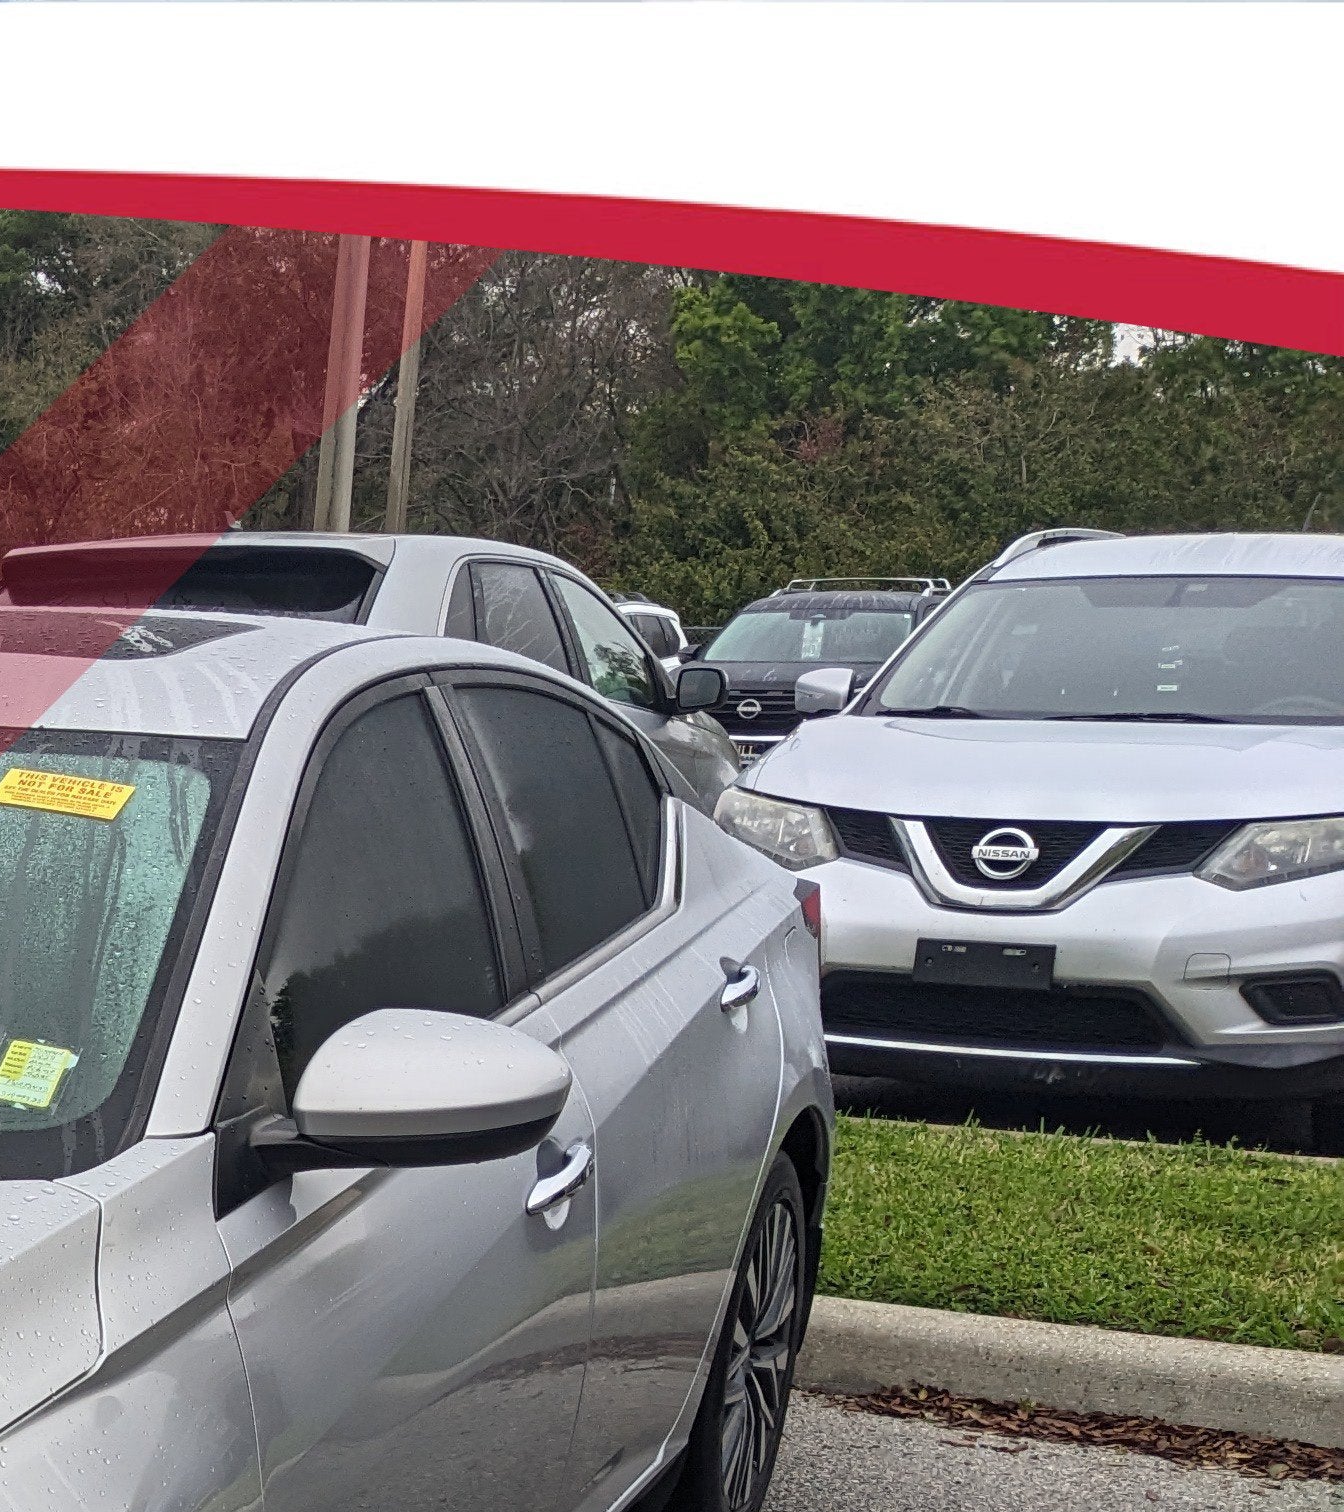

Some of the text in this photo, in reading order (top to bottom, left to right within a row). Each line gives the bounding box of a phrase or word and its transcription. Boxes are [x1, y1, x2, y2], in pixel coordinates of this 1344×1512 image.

[17, 780, 112, 799] NOT FOR SALE
[18, 771, 124, 793] THIS VEHICLE IS
[977, 848, 1030, 859] NISSAN
